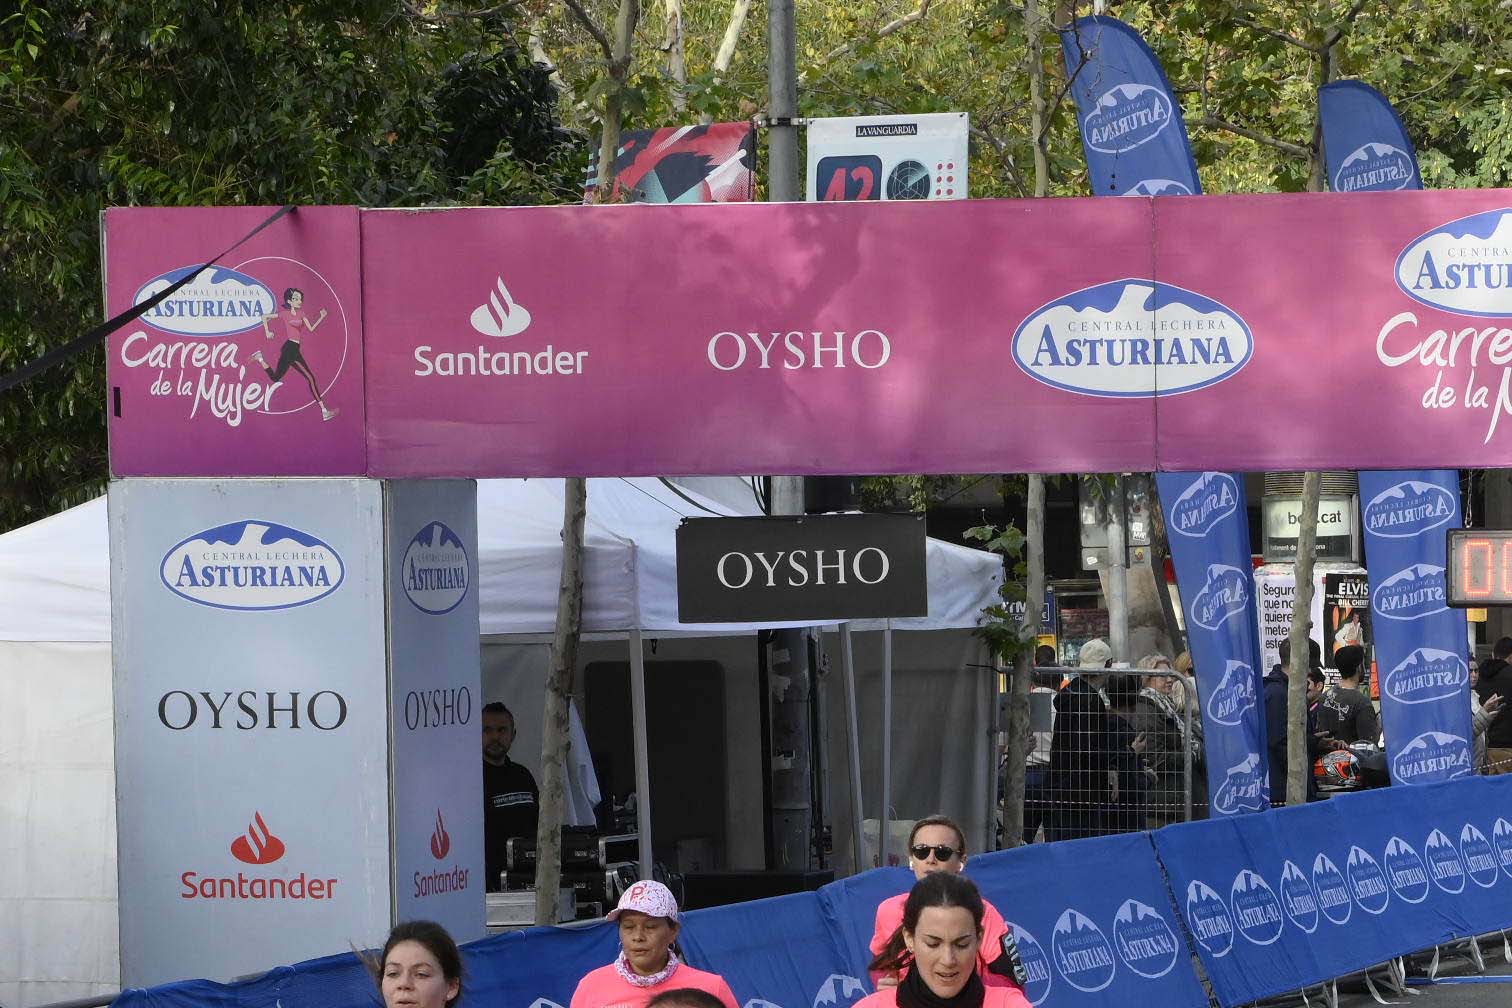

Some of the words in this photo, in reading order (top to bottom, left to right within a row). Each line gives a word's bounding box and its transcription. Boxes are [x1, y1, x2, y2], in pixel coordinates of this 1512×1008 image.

[824, 166, 874, 201] 42
[215, 288, 261, 298] LECHERA
[1068, 320, 1144, 332] CENTRAL
[1151, 319, 1227, 331] LECHERA
[121, 330, 240, 370] Carrera
[414, 344, 589, 377] Santander
[706, 329, 891, 371] OYSHO
[1030, 323, 1235, 367] ASTURIANA
[150, 370, 172, 396] de
[176, 370, 193, 396] la
[190, 364, 284, 427] Mujer
[1421, 370, 1457, 409] de
[1464, 369, 1489, 408] la
[176, 554, 331, 588] ASTURIANA
[203, 552, 260, 561] CENTRAL
[266, 551, 325, 560] LECHERA
[717, 547, 890, 590] OYSHO
[407, 556, 465, 592] ASTURIANA
[1338, 583, 1369, 595] ELVIS
[1263, 599, 1280, 611] que
[1264, 610, 1293, 624] quiere
[157, 689, 348, 731] OYSHO
[403, 685, 472, 731] OYSHO
[181, 871, 338, 900] Santander
[413, 865, 470, 898] Santander
